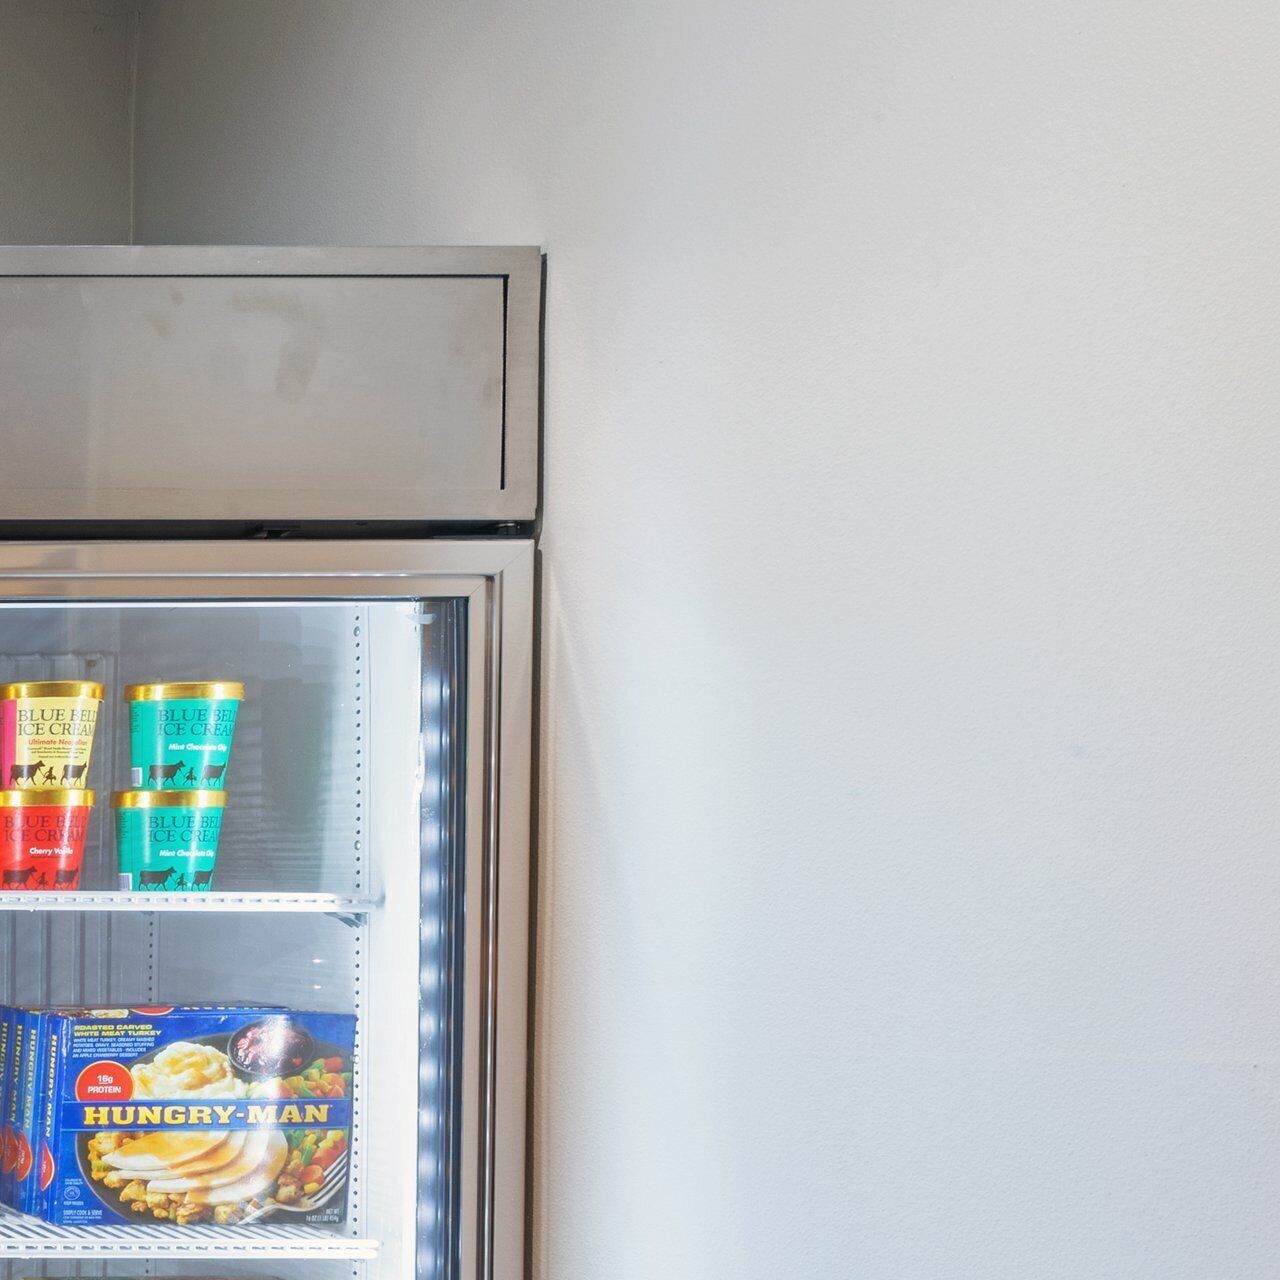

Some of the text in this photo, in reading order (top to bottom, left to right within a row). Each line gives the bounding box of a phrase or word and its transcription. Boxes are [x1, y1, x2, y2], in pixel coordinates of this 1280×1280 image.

[18, 708, 66, 723] BLUE
[157, 709, 208, 722] BLUE
[18, 723, 45, 736] ICE
[157, 723, 185, 736] ICE
[168, 743, 184, 751] Mint
[4, 816, 50, 829] BLUE
[149, 816, 195, 829] BLUE
[4, 829, 32, 842] ICE
[149, 830, 177, 843] ICE
[30, 847, 53, 856] Cherry
[96, 1075, 114, 1084] 16g
[87, 1086, 122, 1094] PROTEIN
[83, 1103, 330, 1126] HUNGRY-MAN
